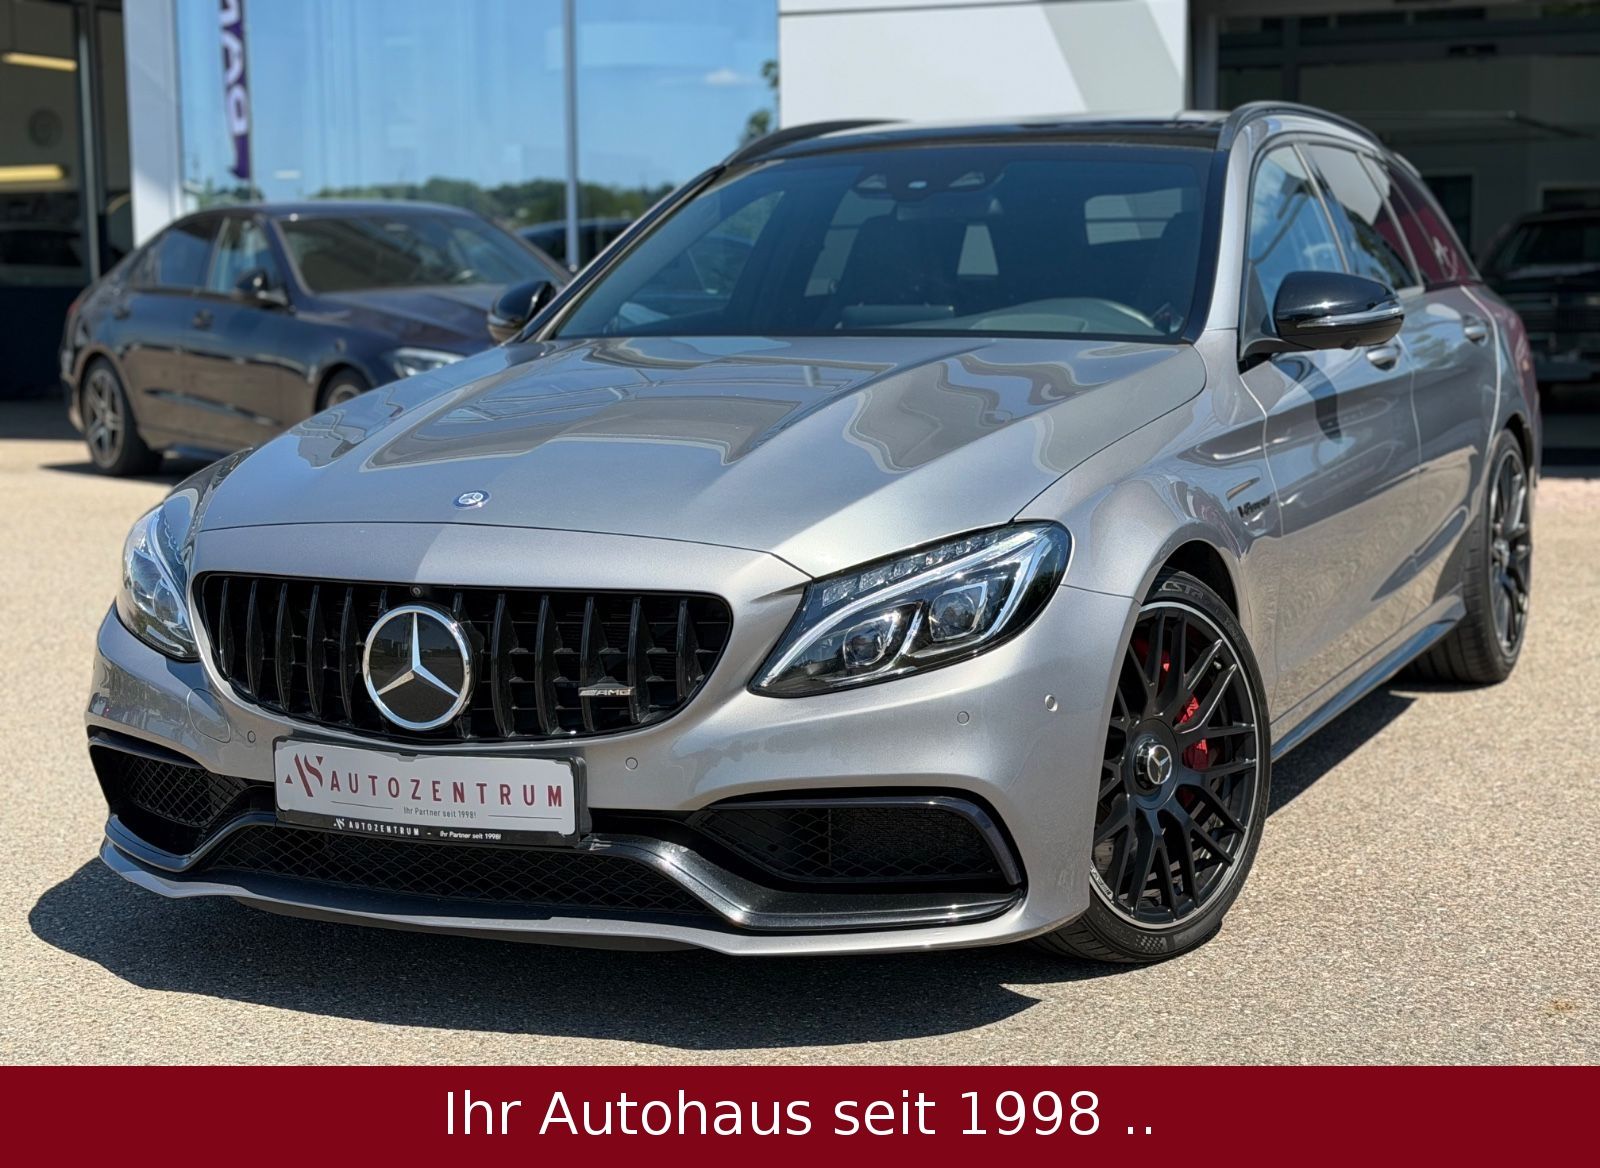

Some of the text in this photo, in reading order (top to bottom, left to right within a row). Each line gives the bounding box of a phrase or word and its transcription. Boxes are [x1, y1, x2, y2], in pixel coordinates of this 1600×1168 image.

[330, 770, 562, 807] AUTOZENTRUM
[404, 806, 413, 814] Ihr
[415, 808, 440, 816] Partner
[458, 810, 476, 819] 1998!
[348, 820, 420, 836] AUTOZENTRUM
[449, 831, 471, 839] Partner
